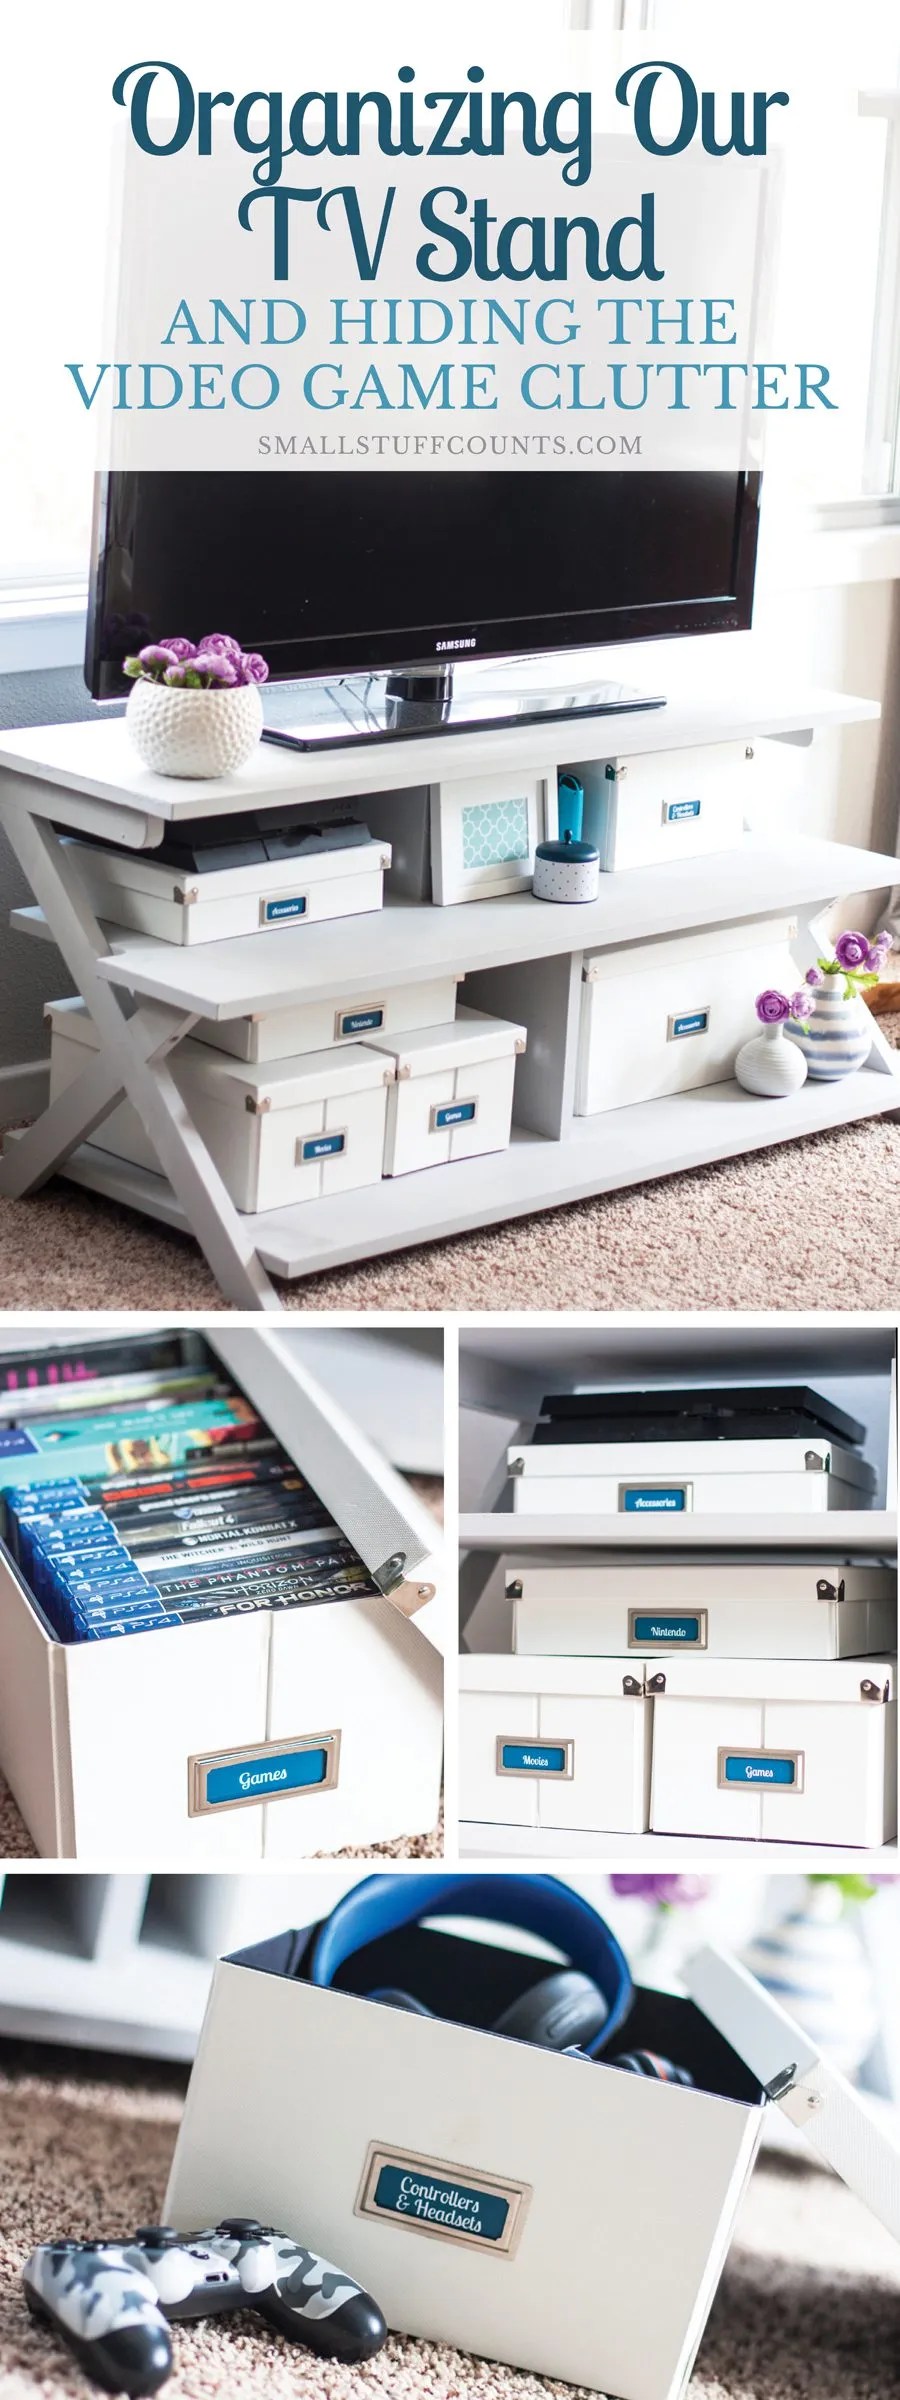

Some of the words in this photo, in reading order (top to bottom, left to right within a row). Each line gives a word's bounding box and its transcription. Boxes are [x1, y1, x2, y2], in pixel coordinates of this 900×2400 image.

[436, 638, 476, 651] SAMSUNG
[634, 1497, 676, 1508] Accessories
[225, 1514, 236, 1524] 4
[198, 1530, 242, 1543] MORTAL
[242, 1520, 288, 1535] KOMBAT
[288, 1520, 299, 1528] X
[81, 1549, 119, 1561] PS4
[180, 1547, 225, 1558] WITCHER
[240, 1539, 264, 1549] WILD
[90, 1562, 129, 1574] PS4
[98, 1576, 137, 1588] PS4
[161, 1580, 200, 1593] THE
[207, 1562, 304, 1586] PHANTOM
[233, 1575, 314, 1596] HORIZON
[256, 1587, 277, 1595] ZERO
[110, 1588, 149, 1600] PS4
[219, 1598, 273, 1616] FOR
[274, 1582, 373, 1606] HONOR
[113, 1603, 153, 1615] PS4
[130, 1616, 173, 1629] PS4
[651, 1626, 687, 1637] Nintendo
[522, 1754, 549, 1767] Movies
[745, 1765, 774, 1779] Games
[239, 1768, 288, 1790] Games
[400, 2176, 480, 2213] Controllers
[395, 2194, 410, 2211] &
[414, 2198, 482, 2233] Headsets
